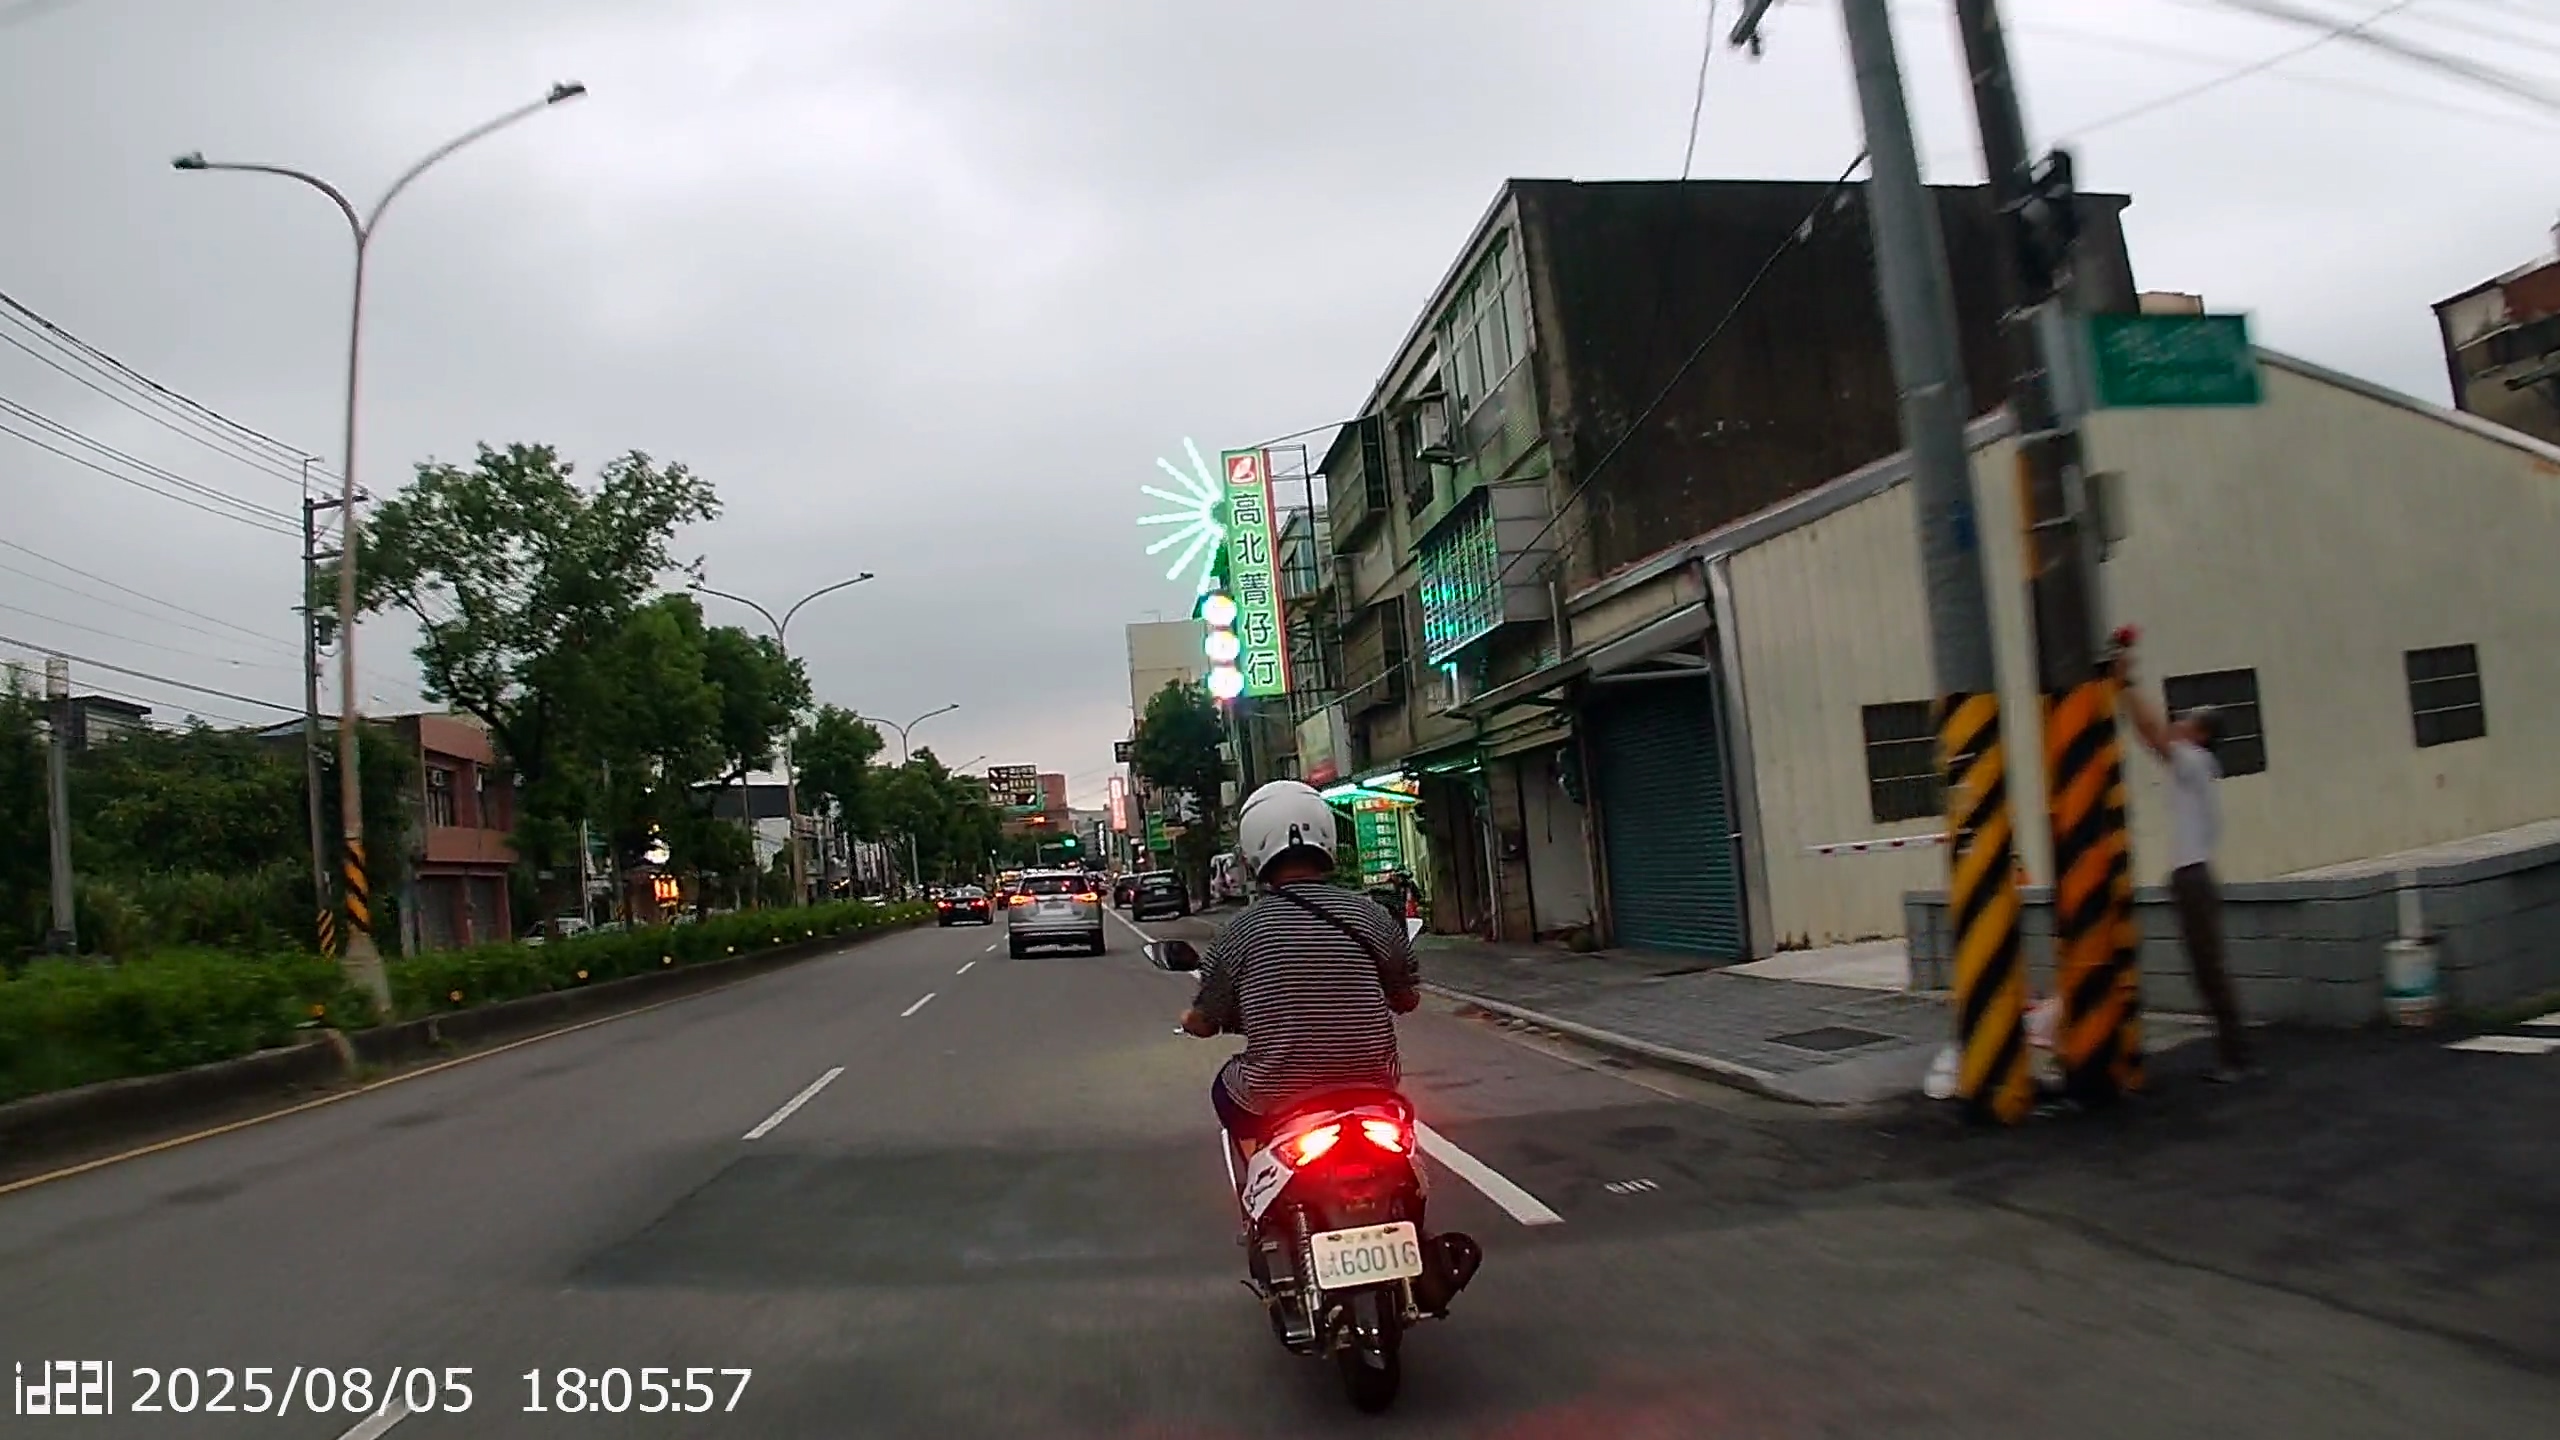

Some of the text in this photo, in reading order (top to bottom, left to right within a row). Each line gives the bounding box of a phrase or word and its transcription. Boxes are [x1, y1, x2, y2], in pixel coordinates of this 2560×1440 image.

[1231, 493, 1277, 687] 高北菁仔行
